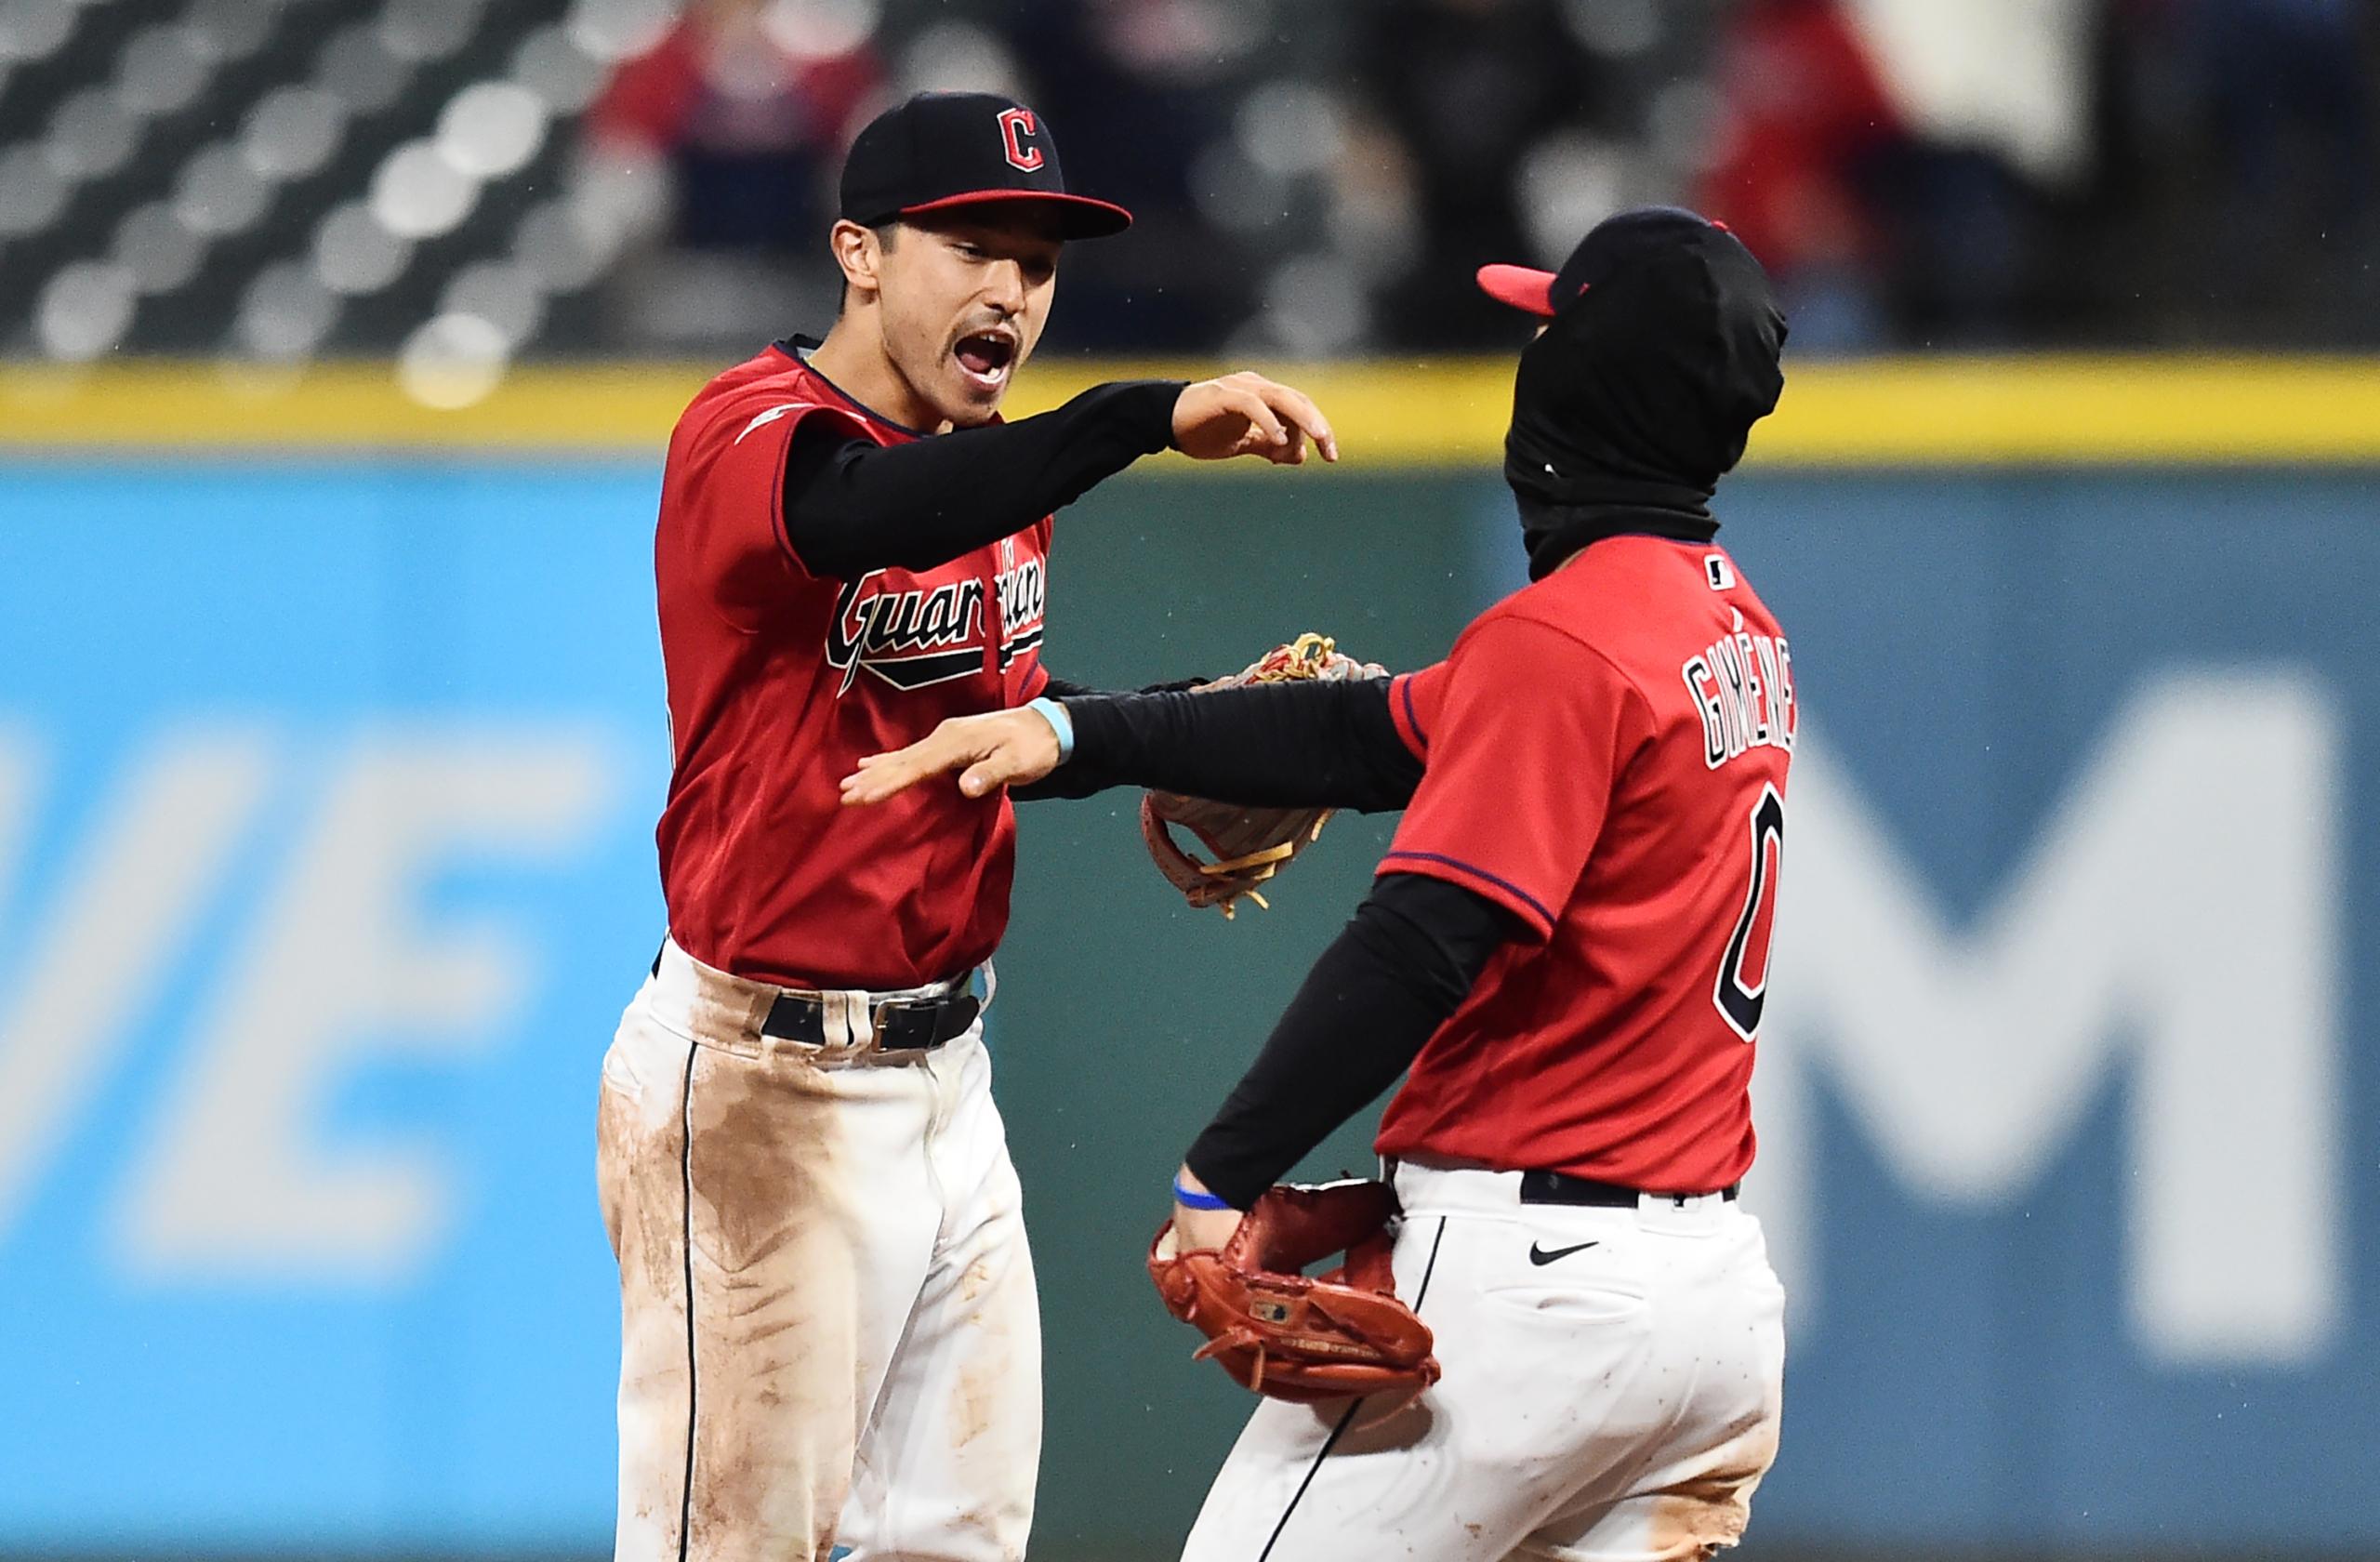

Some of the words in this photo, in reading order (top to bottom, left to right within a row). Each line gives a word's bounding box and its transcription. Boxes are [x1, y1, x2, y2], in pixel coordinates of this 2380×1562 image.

[997, 107, 1045, 173] C
[1682, 606, 1794, 770] GIMÉNE
[1712, 780, 1784, 1043] 0
